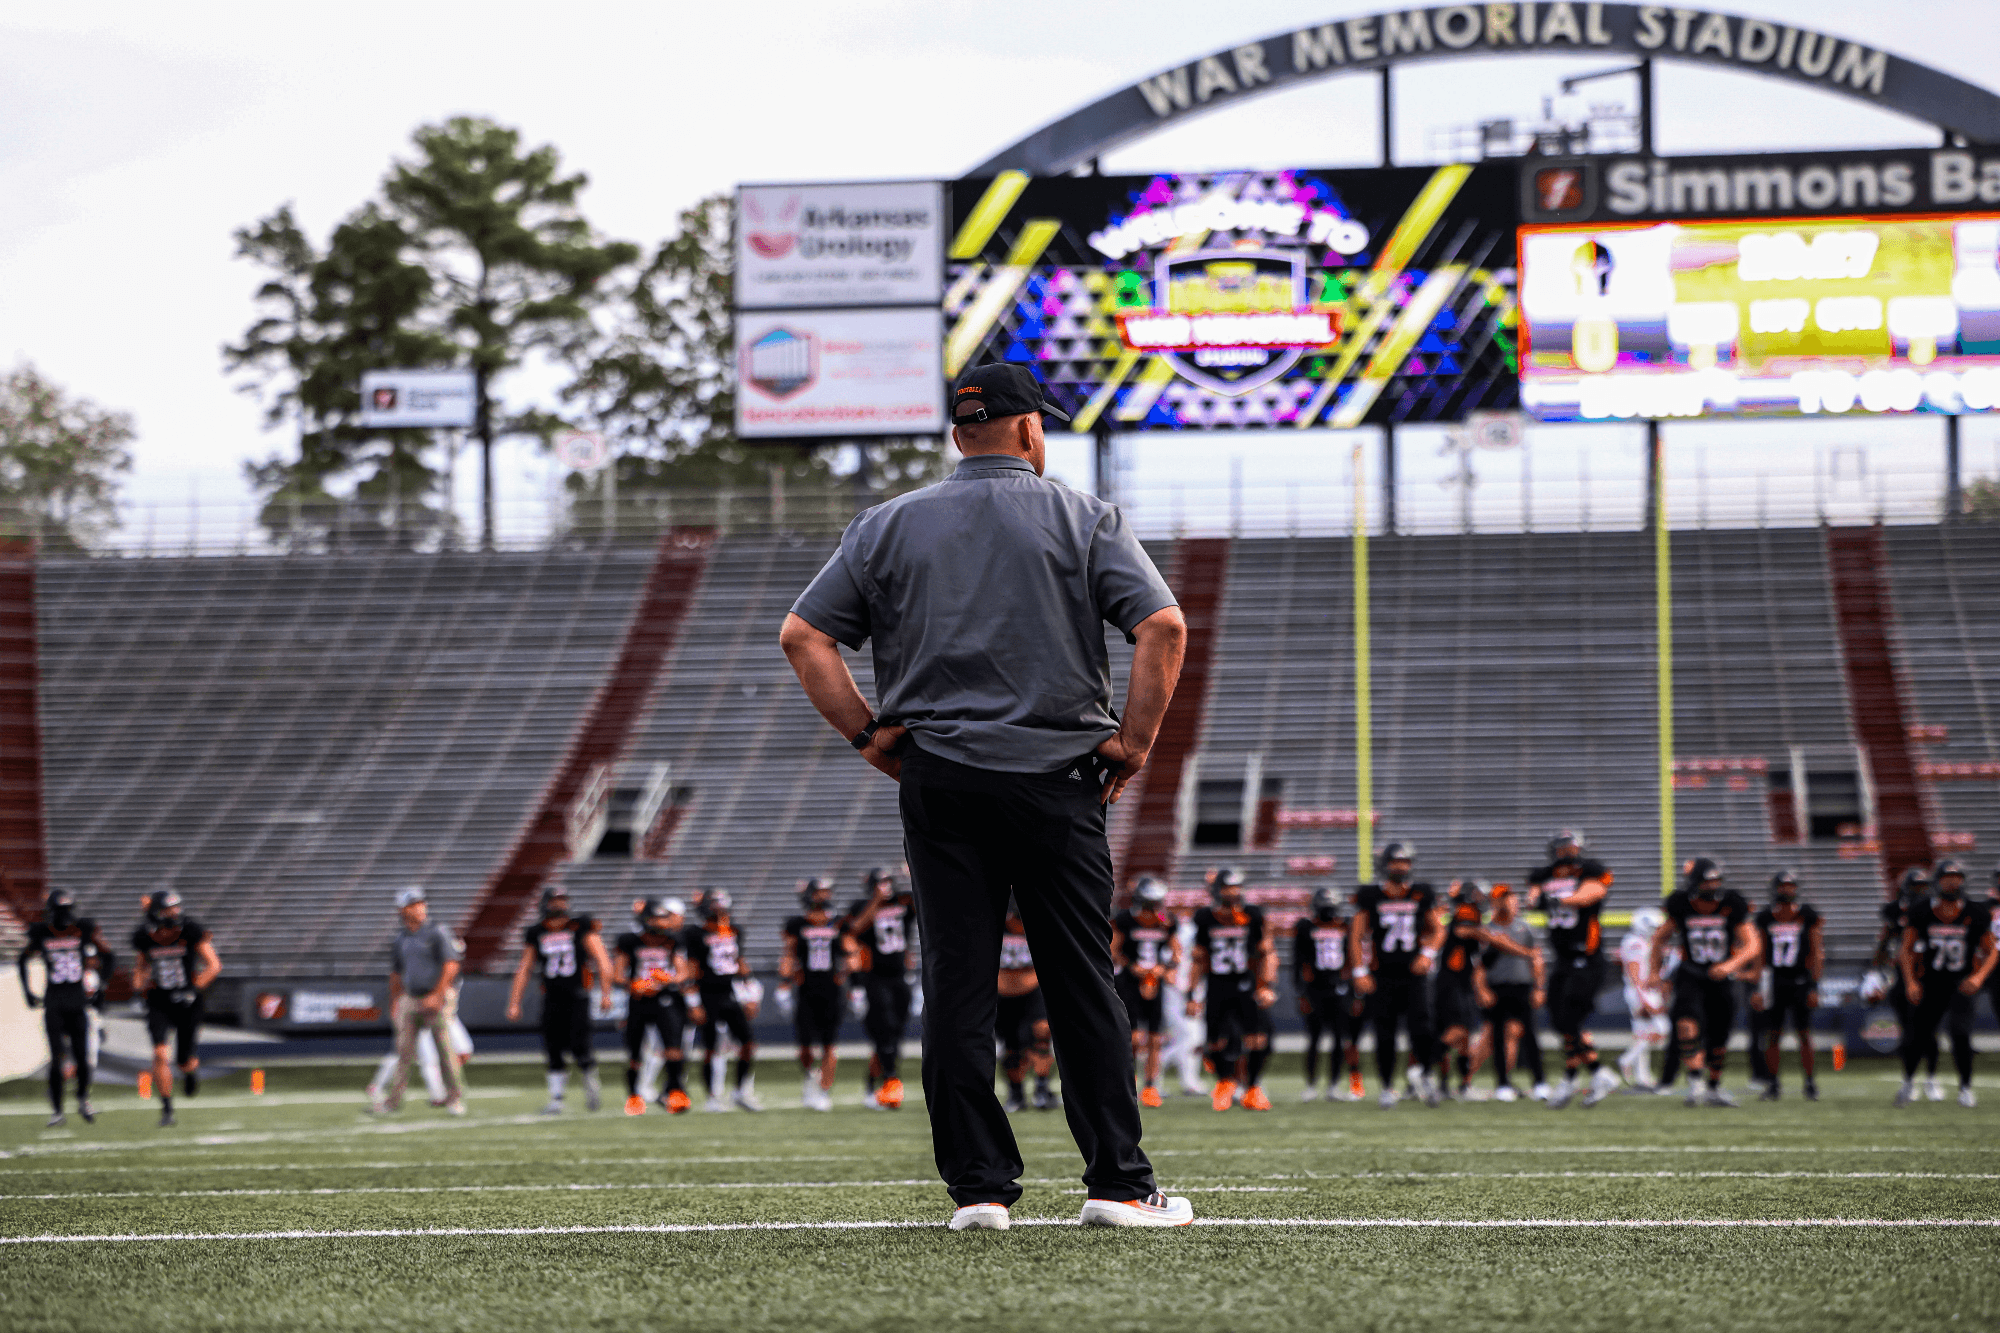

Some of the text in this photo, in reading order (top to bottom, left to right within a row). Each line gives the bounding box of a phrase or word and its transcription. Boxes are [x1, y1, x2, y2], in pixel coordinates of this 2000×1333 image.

[1137, 2, 1888, 117] WAR MEMORIAL STADIUM
[1607, 160, 1915, 214] Simmons
[804, 207, 928, 231] Arkansas
[799, 237, 912, 263] Urology
[957, 386, 983, 395] FOOTBALL
[1772, 932, 1800, 967] 17
[1929, 937, 1966, 972] 79
